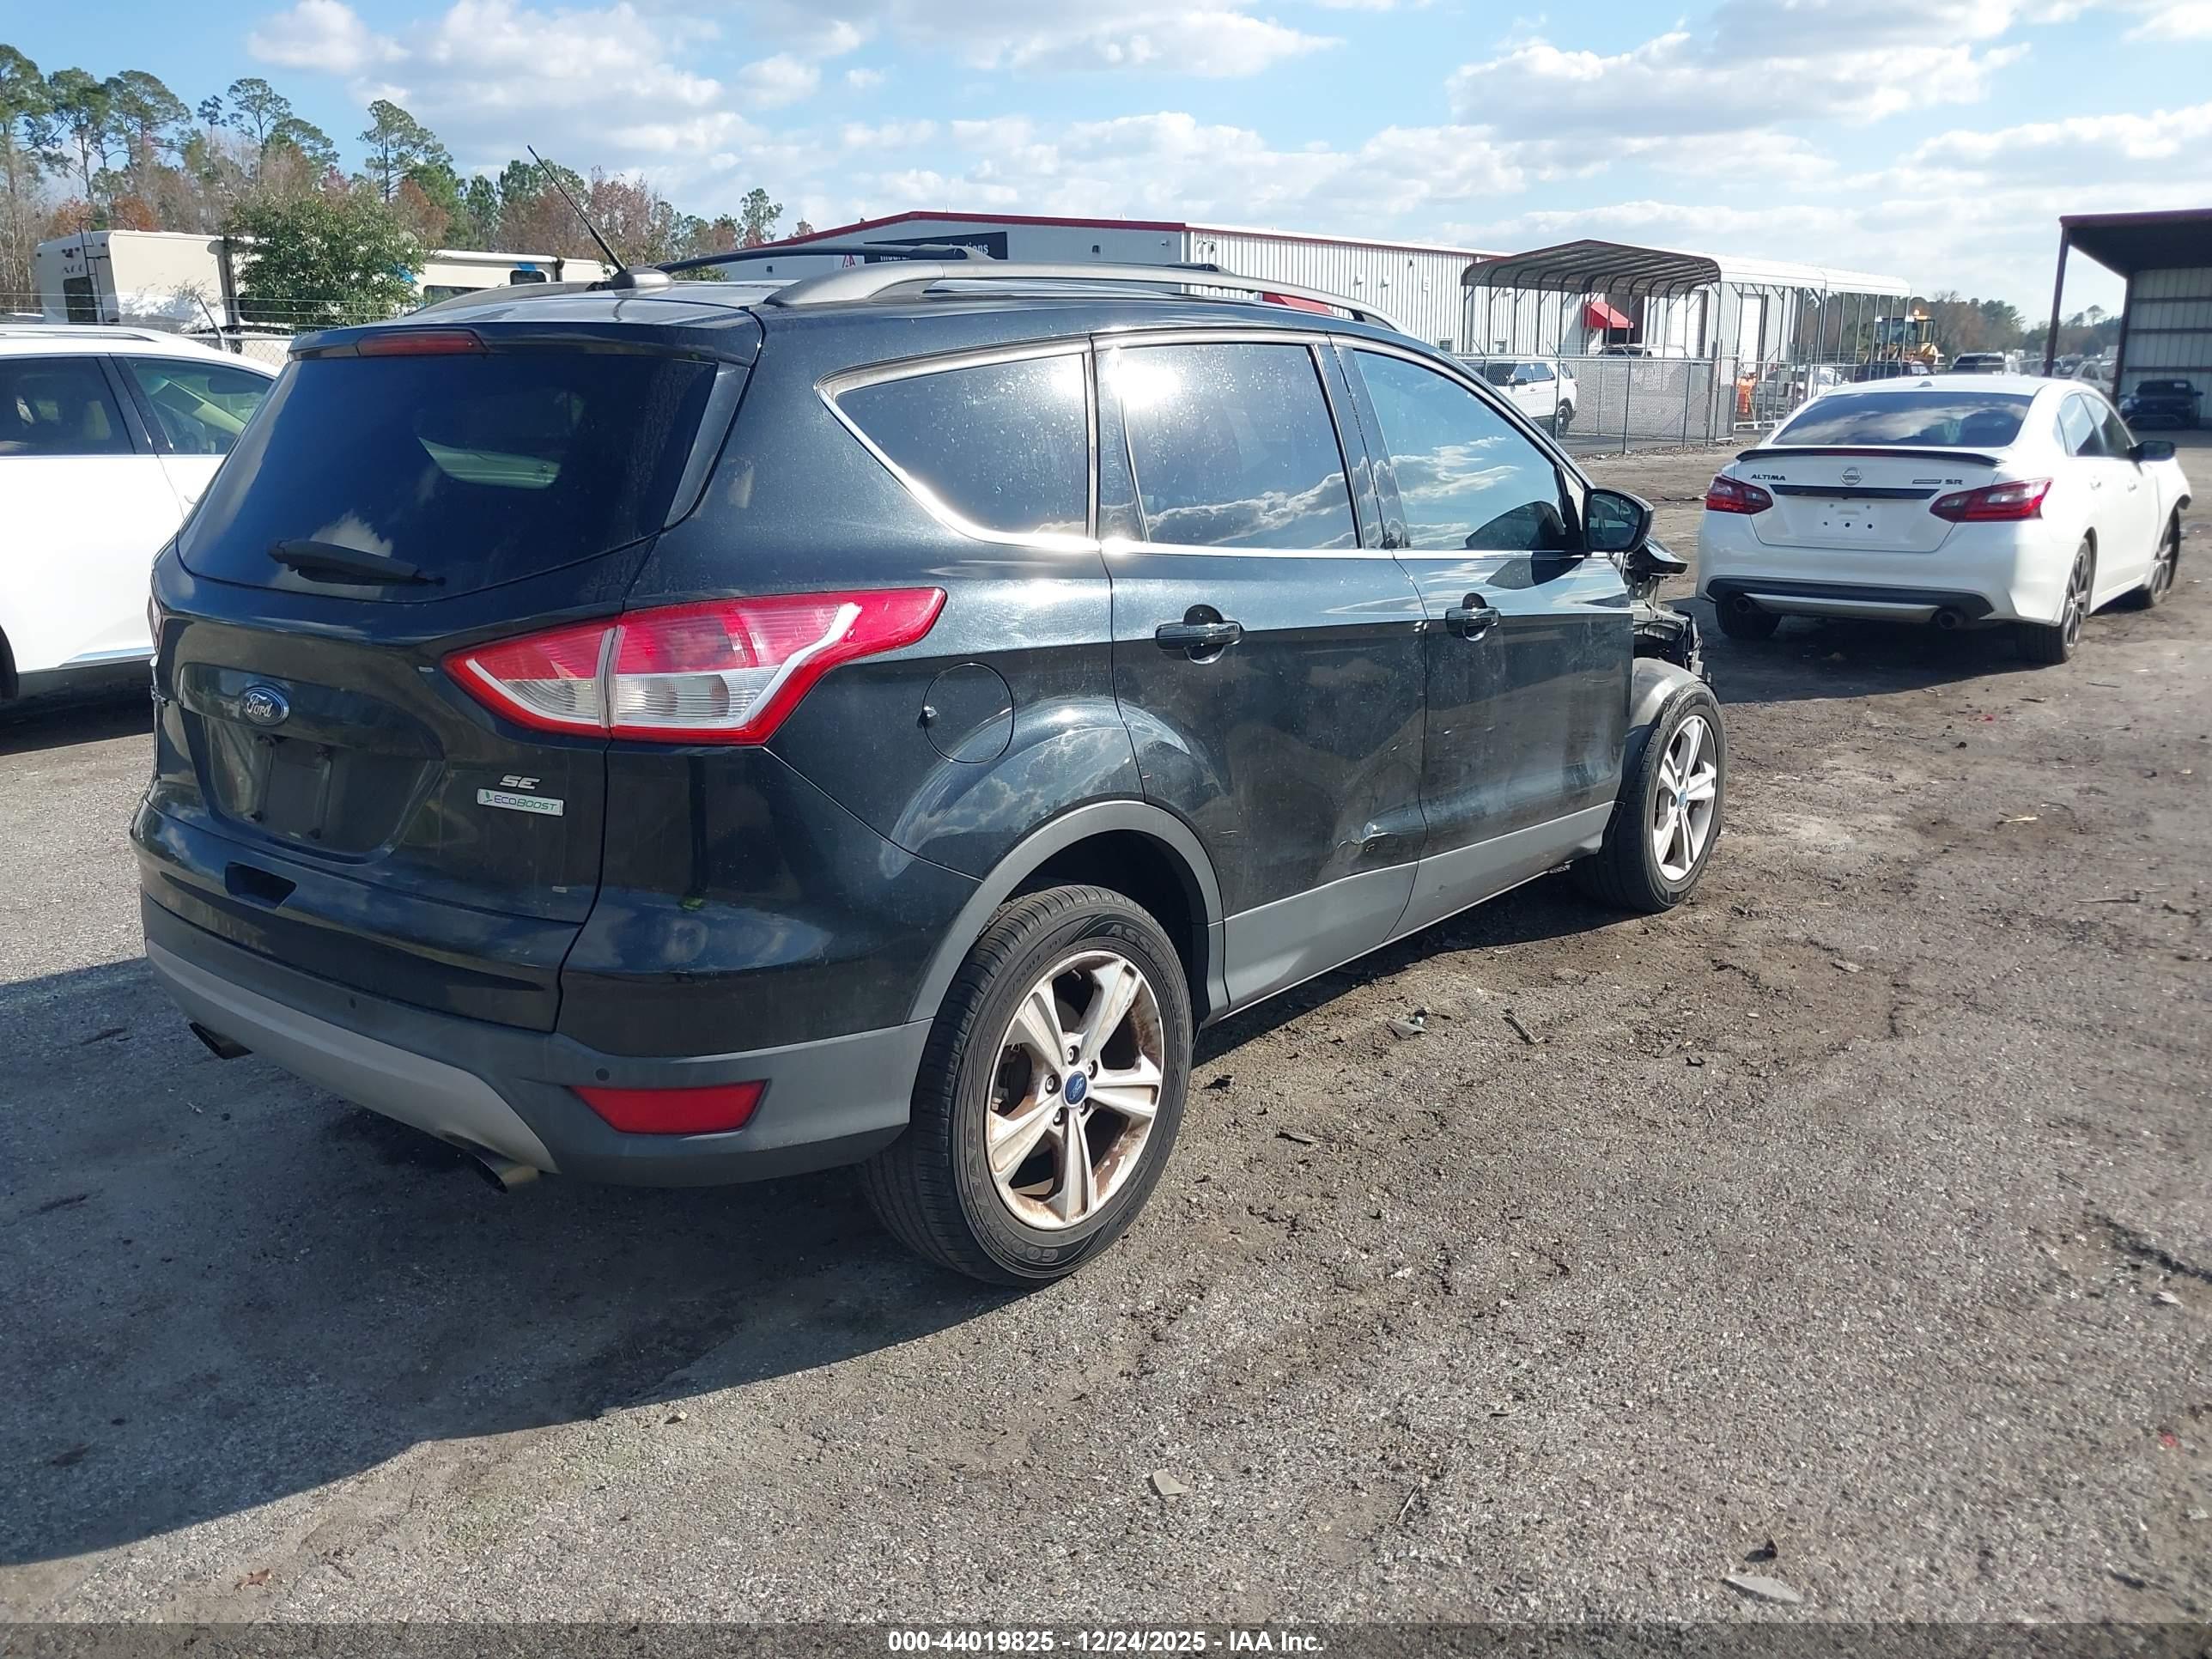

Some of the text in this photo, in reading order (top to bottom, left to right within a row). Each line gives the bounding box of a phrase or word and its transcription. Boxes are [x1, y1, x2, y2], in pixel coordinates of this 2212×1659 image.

[246, 693, 273, 718] Ford
[499, 775, 541, 790] SE
[494, 795, 557, 811] ECOBOOST
